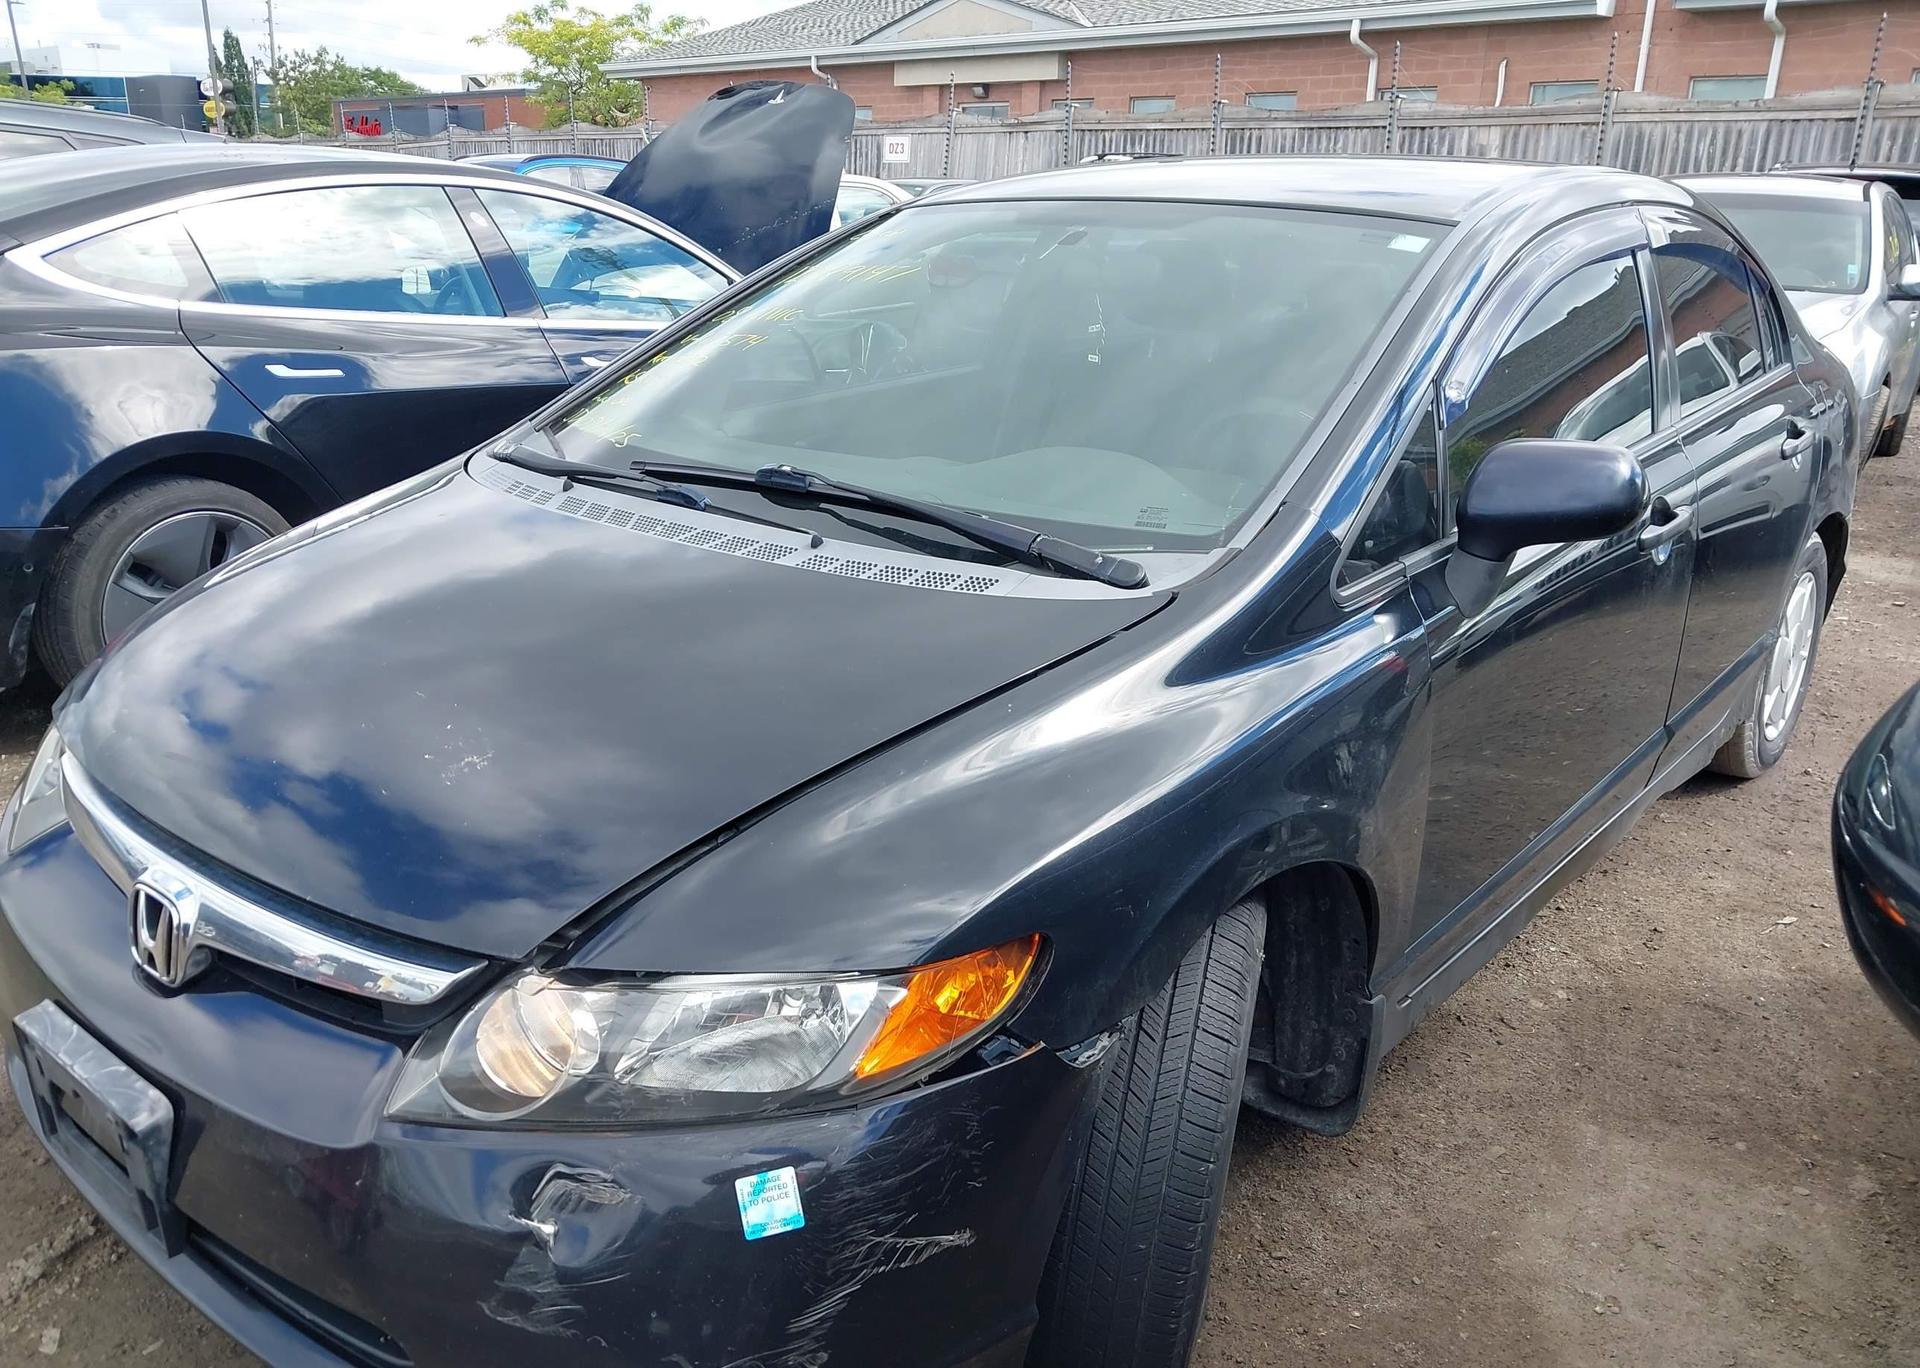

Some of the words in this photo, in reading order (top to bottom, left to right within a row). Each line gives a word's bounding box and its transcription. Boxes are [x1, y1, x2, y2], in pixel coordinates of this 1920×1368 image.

[889, 143, 905, 154] DZ3
[749, 1175, 782, 1188] DAMAGE
[747, 1183, 788, 1198] REPORTED
[748, 1198, 760, 1207] TO
[761, 1191, 791, 1204] POLICE
[760, 1217, 788, 1228] COLLISION
